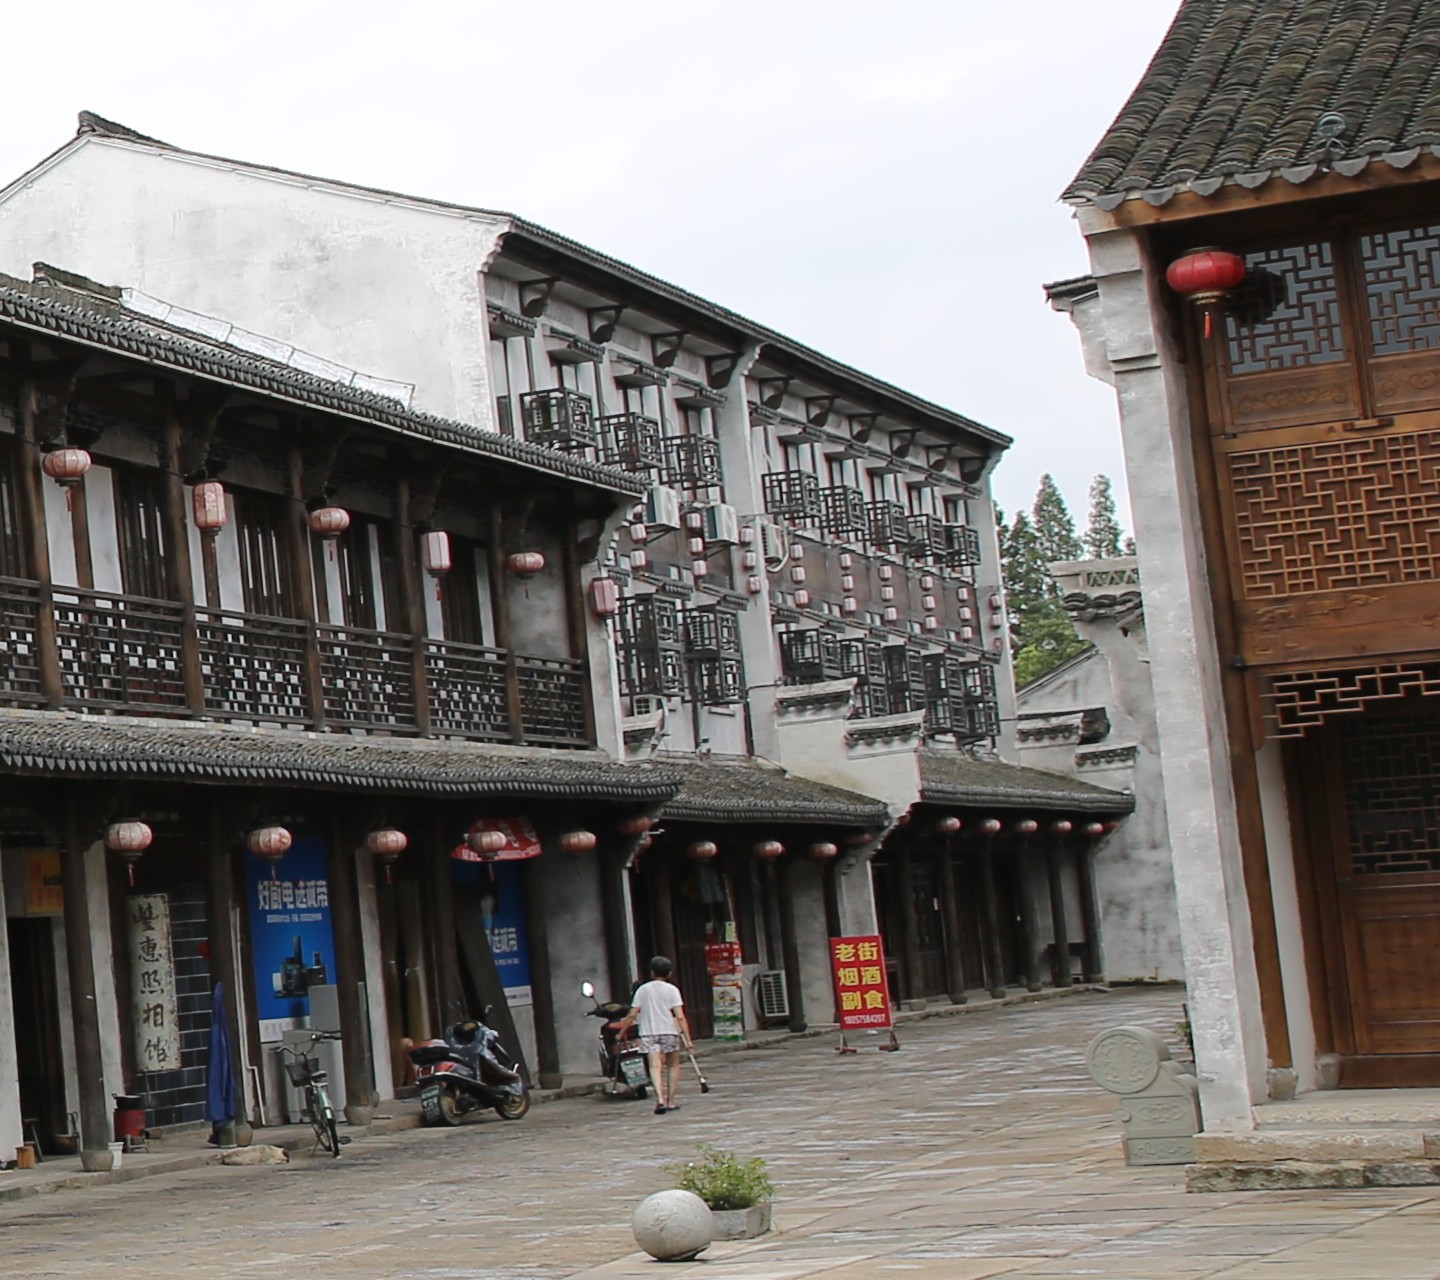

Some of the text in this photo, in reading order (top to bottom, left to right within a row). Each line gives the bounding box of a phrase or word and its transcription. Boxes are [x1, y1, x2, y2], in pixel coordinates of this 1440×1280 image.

[835, 941, 879, 963] 老街
[837, 965, 882, 987] 烟酒
[840, 989, 886, 1011] 副食
